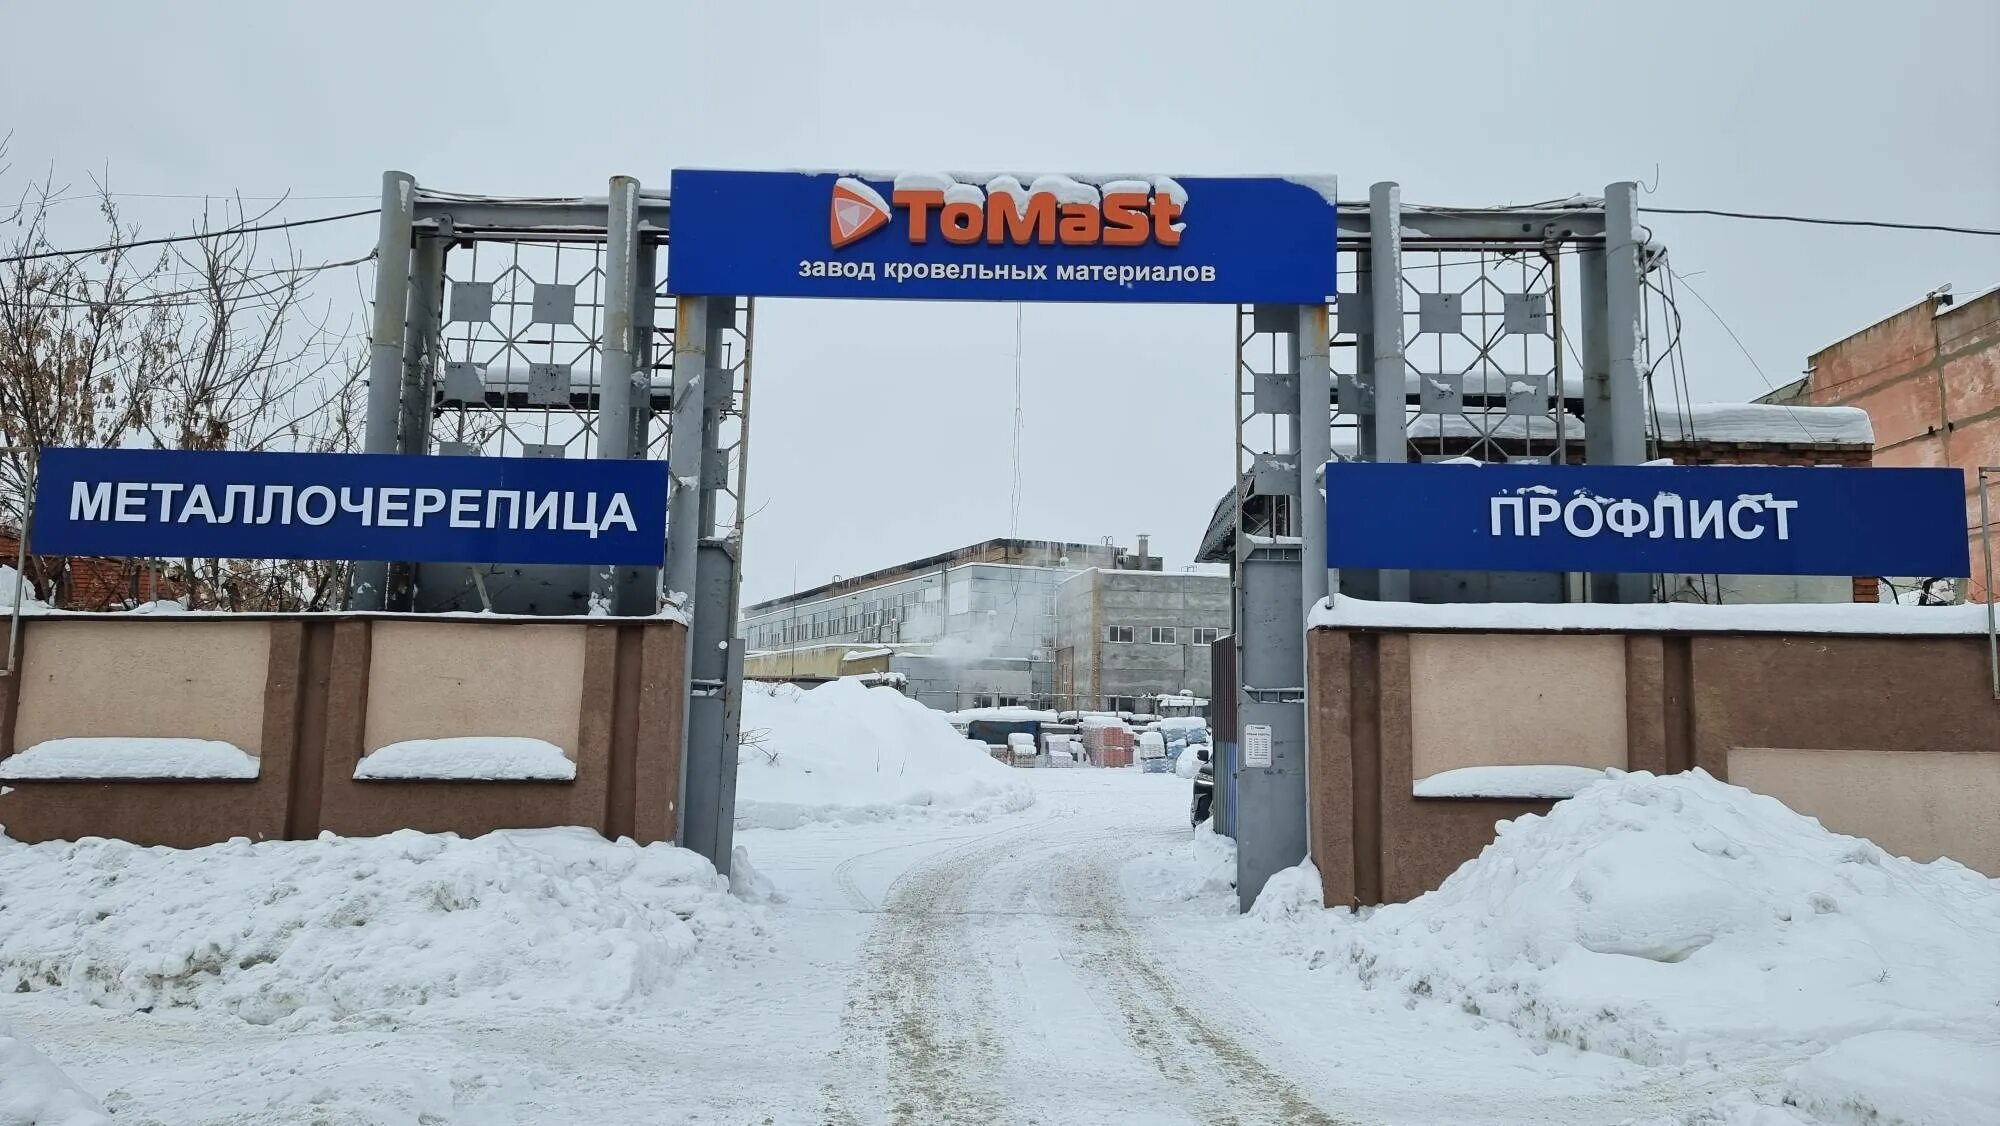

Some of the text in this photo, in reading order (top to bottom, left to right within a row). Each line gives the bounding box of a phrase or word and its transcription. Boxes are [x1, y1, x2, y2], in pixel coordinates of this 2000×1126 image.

[892, 187, 1184, 246] ToMaSt
[798, 260, 1216, 286] завод кровельных материалов
[68, 480, 638, 540] МЕТАЛЛОЧЕРЕПИЦА
[1489, 492, 1799, 540] ПРОФЛИСТ
